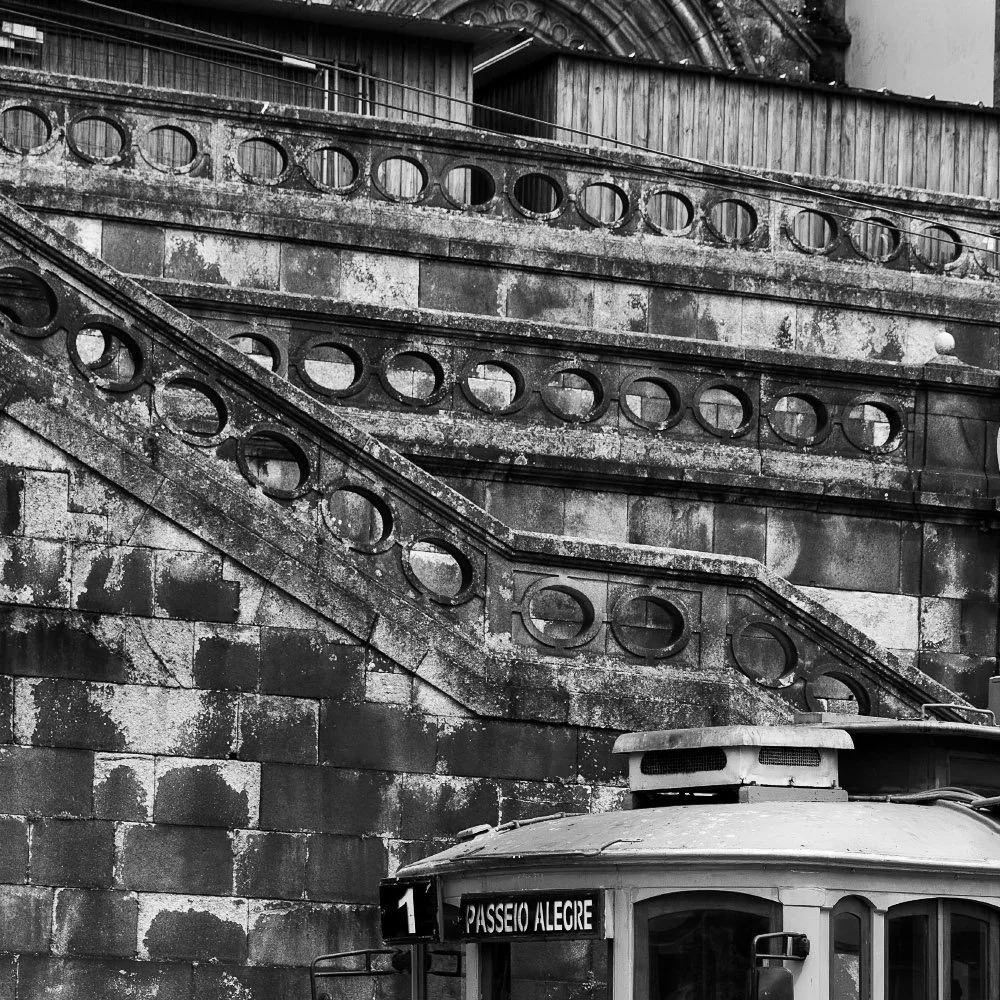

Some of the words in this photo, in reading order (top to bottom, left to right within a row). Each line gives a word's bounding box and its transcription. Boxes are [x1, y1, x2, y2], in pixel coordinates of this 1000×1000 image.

[398, 887, 416, 934] 1
[466, 901, 529, 934] PASSEIO
[534, 899, 593, 932] ALEGRE
